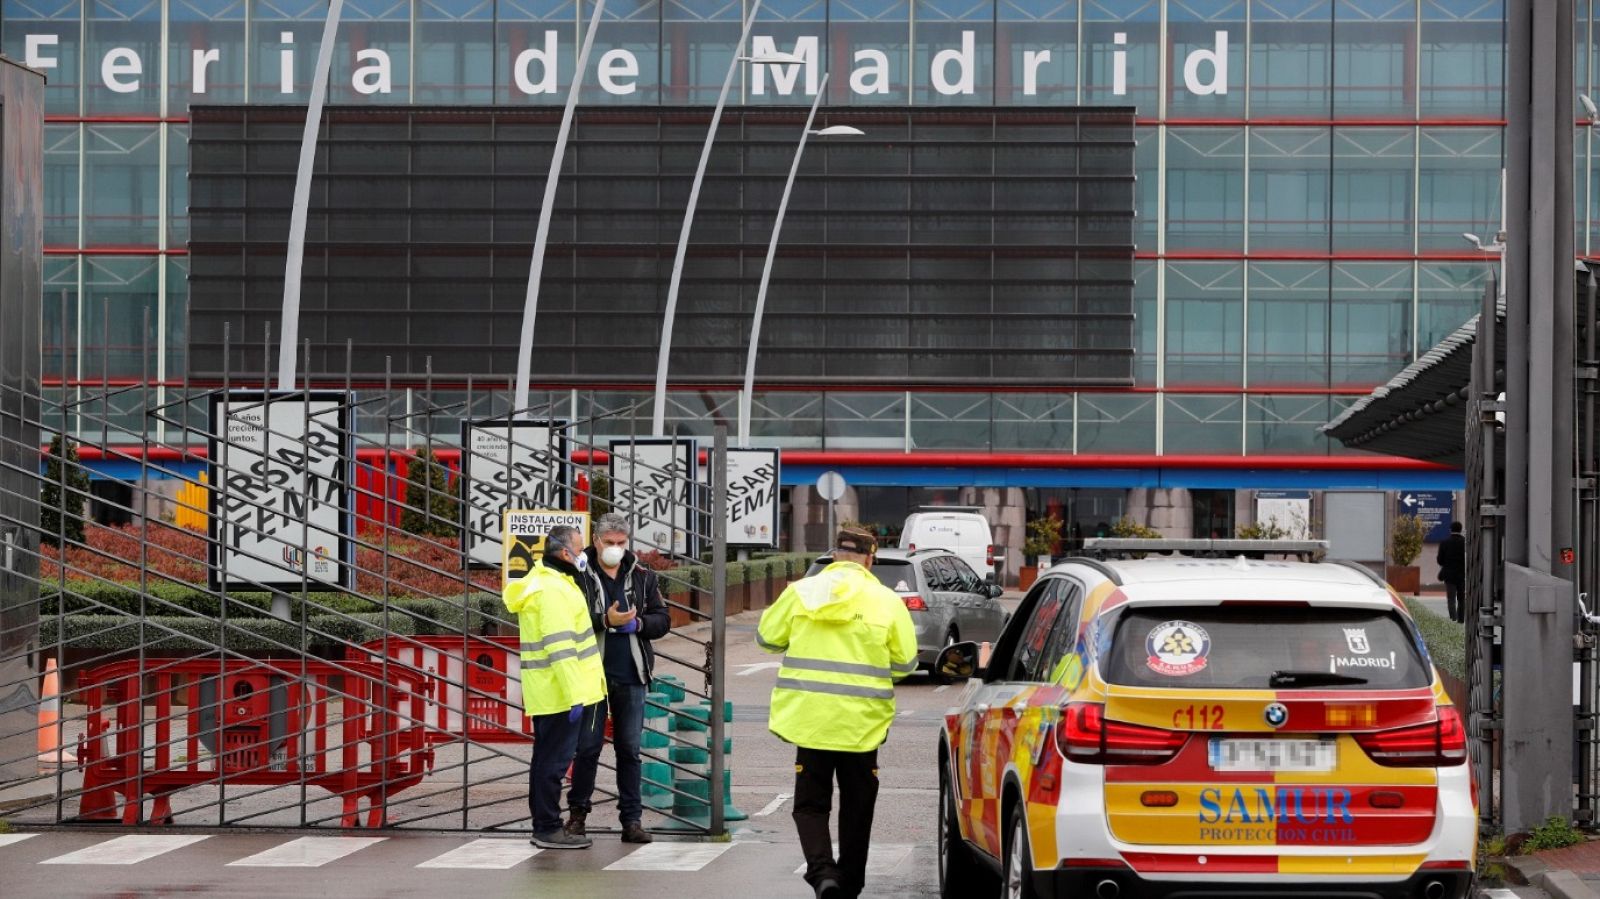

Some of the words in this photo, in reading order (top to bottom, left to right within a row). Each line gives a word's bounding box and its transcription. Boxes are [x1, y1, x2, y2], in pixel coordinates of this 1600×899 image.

[25, 32, 392, 94] Feria
[514, 30, 639, 95] de
[752, 30, 1228, 95] Madrid
[229, 424, 265, 432] creciend
[1199, 787, 1355, 824] SAMUR
[1311, 828, 1357, 841] CIVIL
